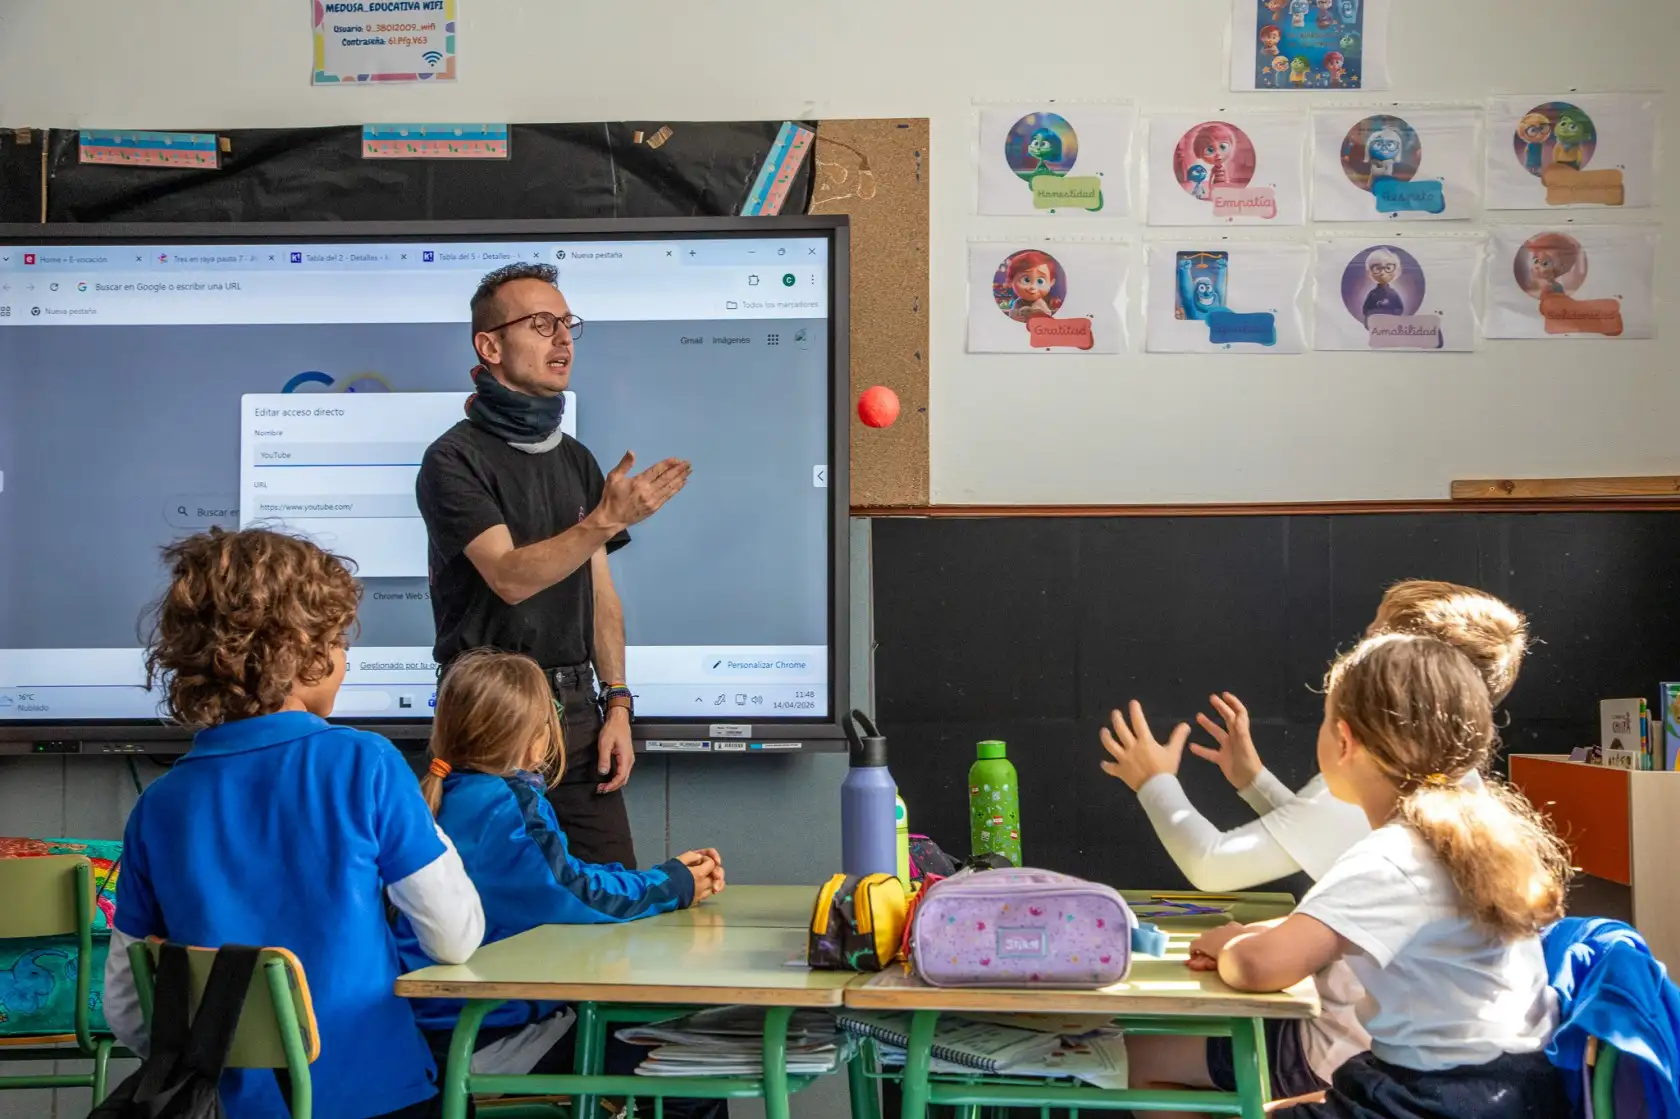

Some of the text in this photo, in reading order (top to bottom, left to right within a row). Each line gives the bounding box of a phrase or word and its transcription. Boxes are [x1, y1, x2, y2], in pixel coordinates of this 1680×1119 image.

[325, 1, 443, 13] MEDUSA_EDUCATIVA WIFI
[1036, 187, 1096, 200] Honestidad
[1214, 196, 1272, 212] Empatía
[40, 256, 61, 264] Home
[306, 254, 325, 263] Tabla
[326, 254, 337, 263] del
[350, 254, 377, 263] Detalles
[439, 253, 456, 262] Tabla
[571, 251, 623, 261] Nueva pestaña
[95, 283, 123, 291] Buscar
[136, 282, 166, 293] Google
[176, 282, 205, 291] escribir
[225, 282, 241, 291] URL
[742, 300, 819, 309] Todos los marcadores
[45, 307, 67, 316] Nueva
[1033, 323, 1088, 338] Gratitud
[1371, 324, 1438, 338] Amabilidad
[680, 337, 703, 345] Gmail
[254, 407, 345, 417] Editar acceso directo
[254, 429, 283, 437] Nombre
[260, 450, 291, 460] YouTube
[253, 480, 267, 489] URL
[197, 507, 228, 518] Buscar
[260, 503, 353, 513] https://www.youtube.com/
[373, 591, 404, 601] Chrome
[405, 591, 423, 601] Web
[360, 661, 404, 670] Gestionado
[406, 662, 419, 670] por
[727, 660, 806, 670] Personalizar Chrome
[773, 701, 815, 709] 14/04/2026
